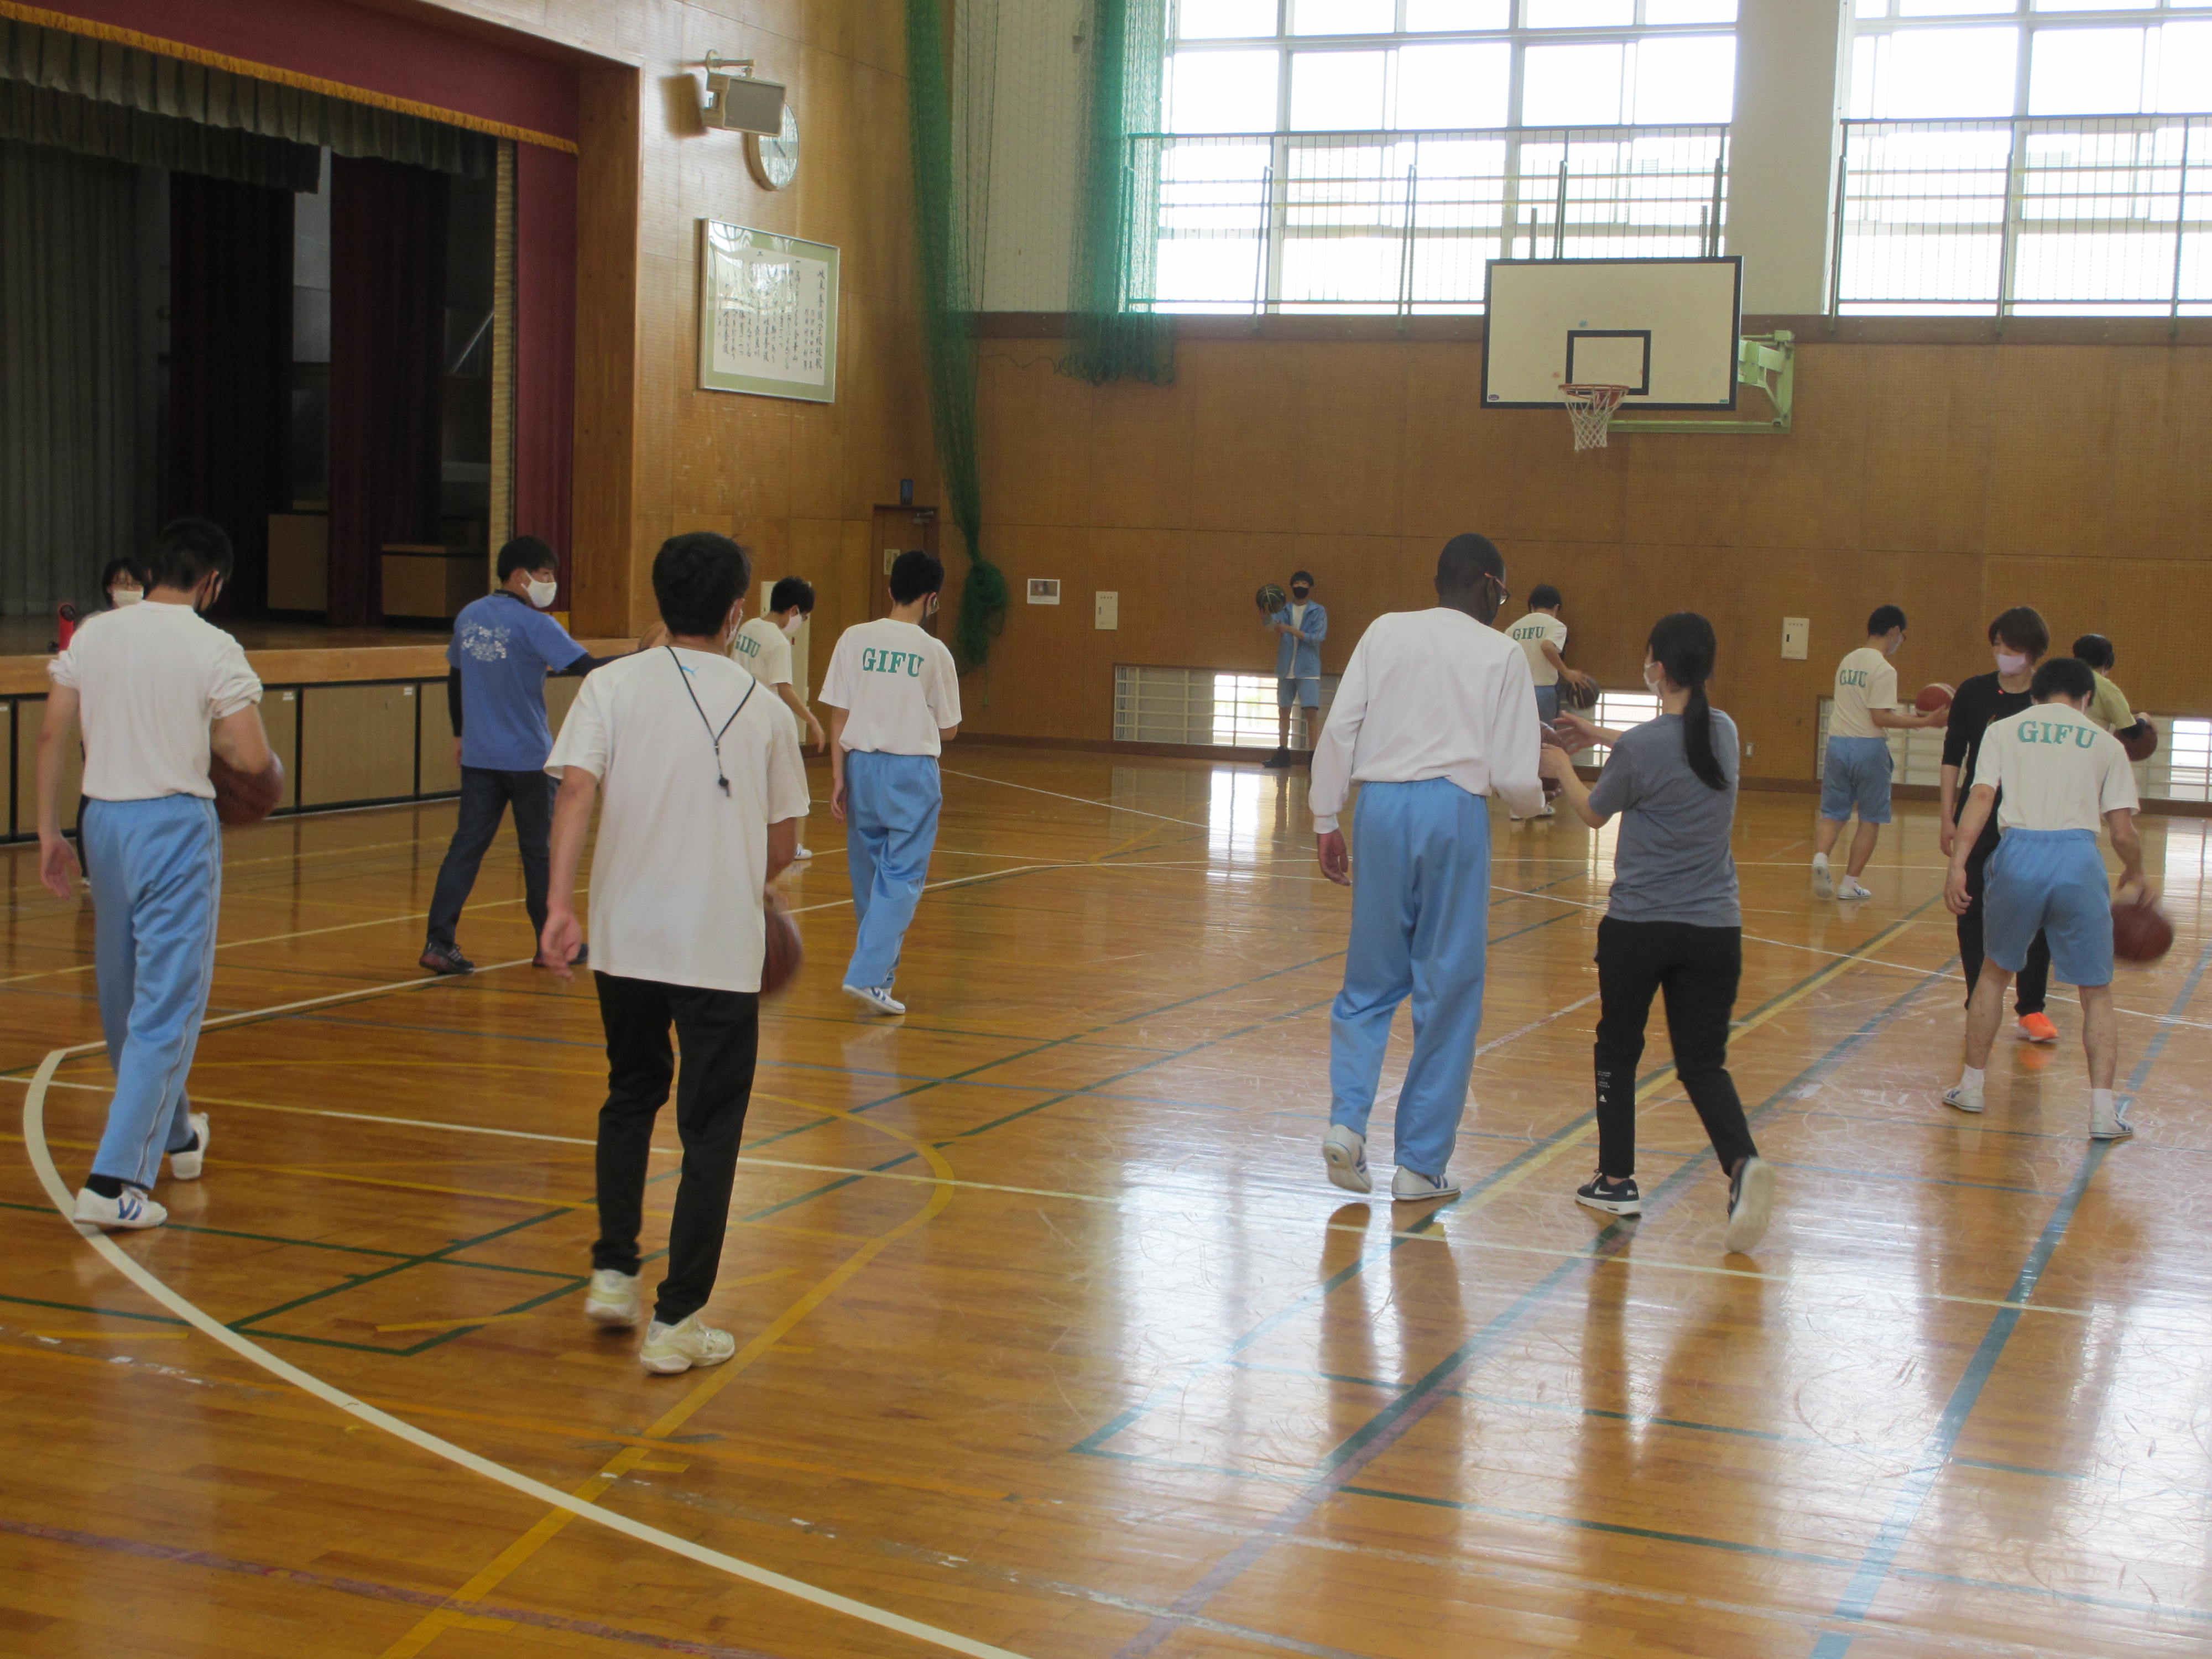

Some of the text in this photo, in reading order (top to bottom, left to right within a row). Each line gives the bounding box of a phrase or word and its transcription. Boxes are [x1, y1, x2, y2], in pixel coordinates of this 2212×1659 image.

[1513, 627, 1545, 640] GIFU
[862, 647, 924, 677] GIFU
[2018, 721, 2098, 748] GIFU
